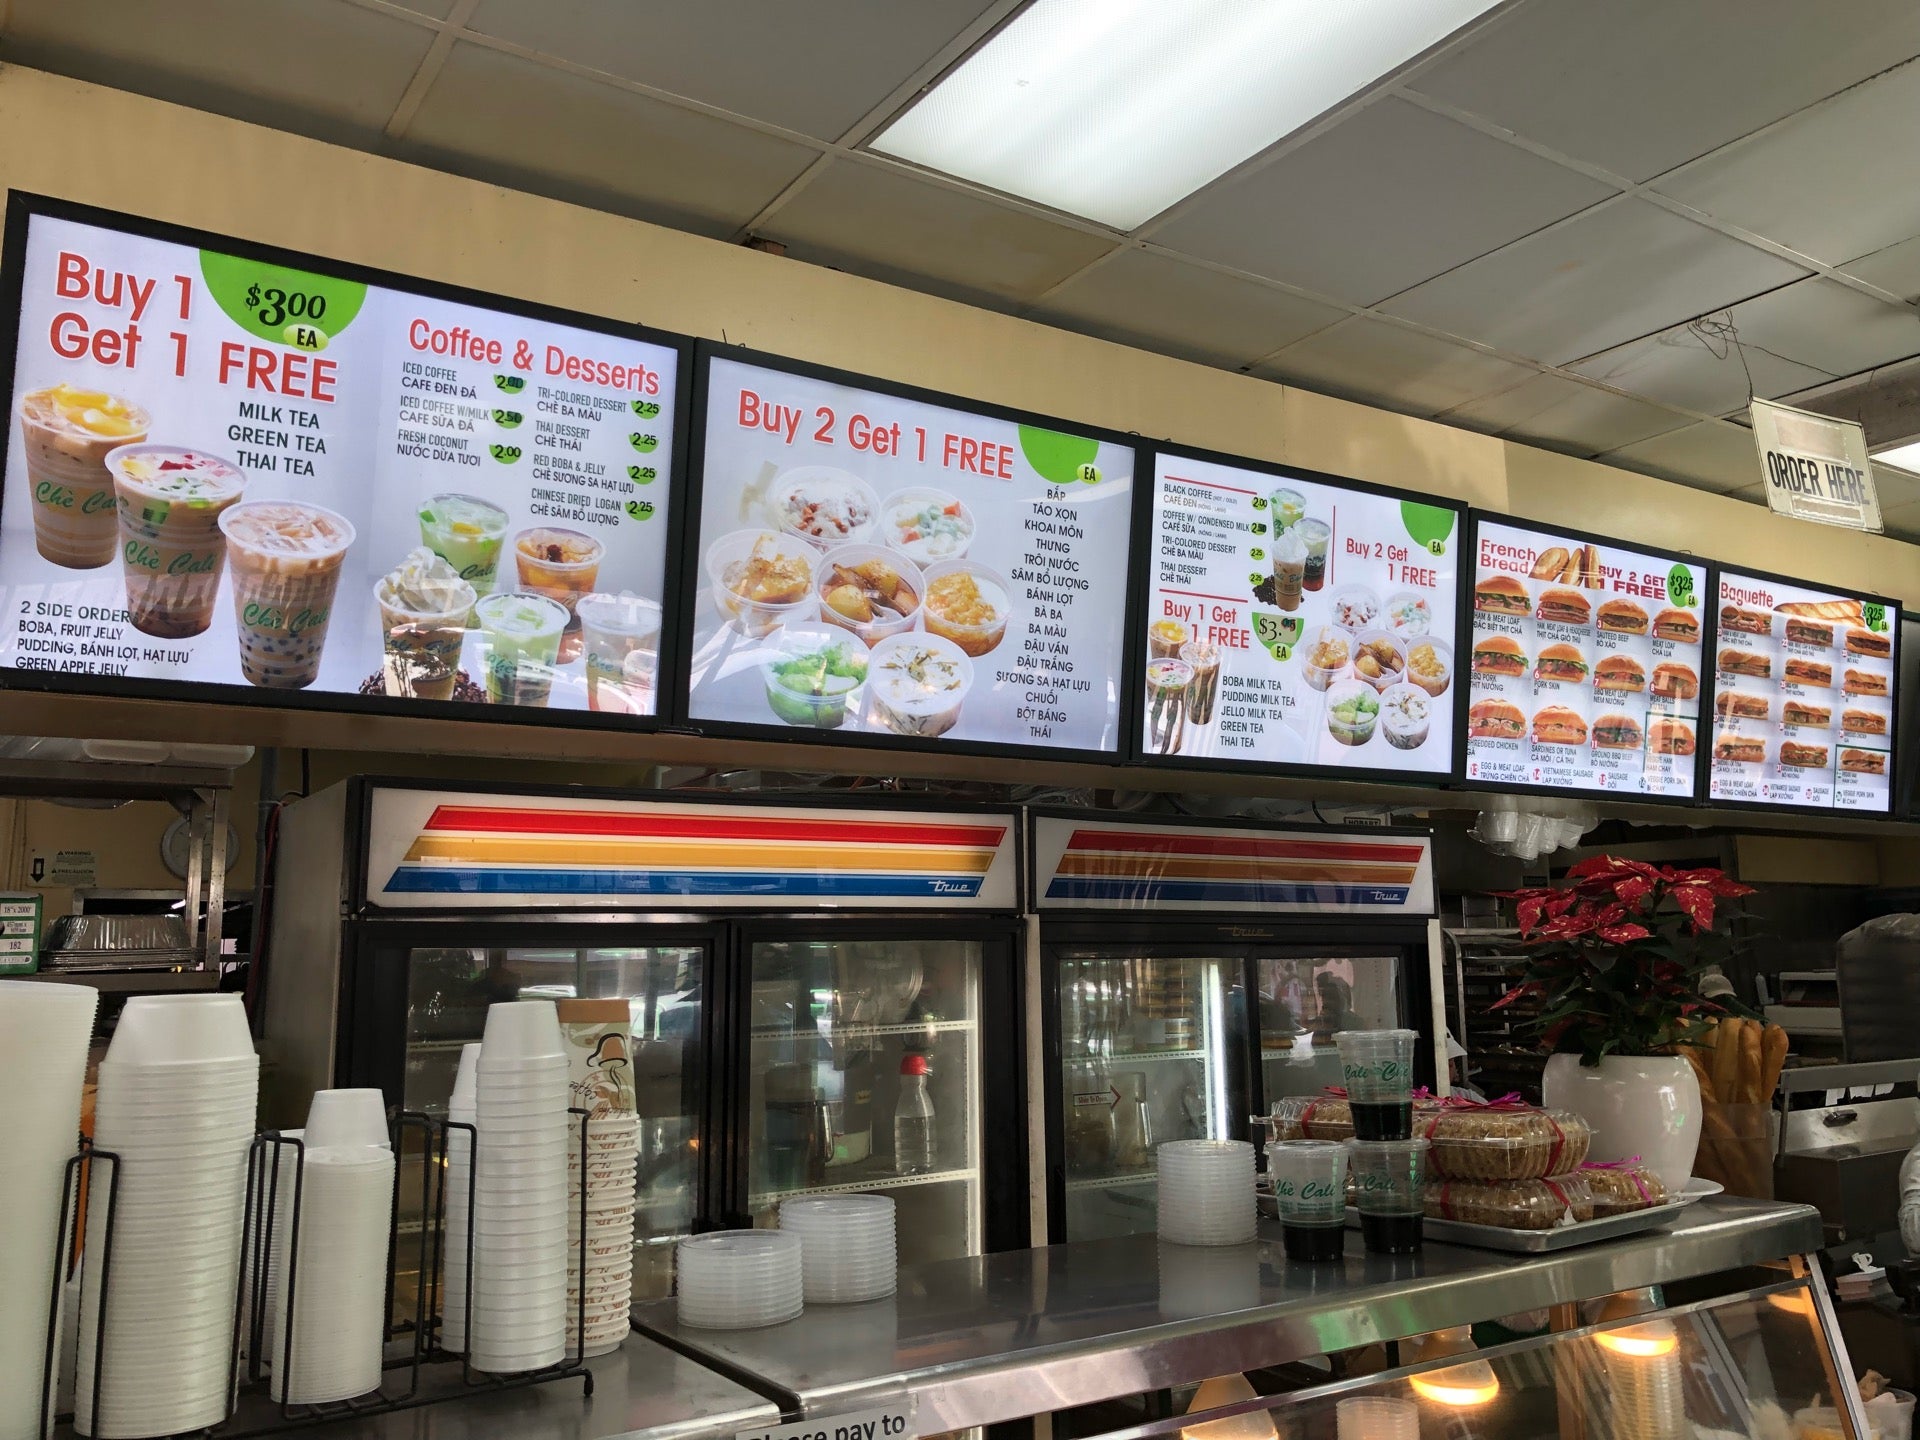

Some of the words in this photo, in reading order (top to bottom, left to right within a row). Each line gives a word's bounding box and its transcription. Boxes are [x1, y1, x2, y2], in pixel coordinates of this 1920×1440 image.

[57, 252, 156, 321] Buy
[174, 275, 191, 319] 1
[297, 328, 318, 347] EA
[51, 313, 141, 368] Get
[170, 332, 188, 377] 1
[219, 342, 338, 402] FREE
[410, 319, 502, 364] Coffee
[512, 340, 533, 370] &
[546, 346, 659, 394] Desserts
[403, 361, 422, 375] ICED
[425, 366, 456, 381] COFFEE
[402, 377, 431, 391] CAFE
[435, 382, 457, 395] ĐEN
[461, 387, 476, 399] ĐÁ
[400, 395, 419, 408] ICED
[423, 400, 454, 415] COFFEE
[457, 405, 489, 420] W/MILK
[538, 387, 590, 406] TRI-COLORED
[594, 398, 626, 412] DESSERT
[635, 401, 659, 414] 2.25
[239, 402, 282, 423] MILK
[289, 411, 319, 428] TEA
[400, 410, 428, 424] CAFE
[537, 401, 558, 413] CHÈ
[562, 406, 575, 417] BA
[578, 408, 601, 421] MÀU
[536, 420, 553, 433] THAI
[556, 424, 590, 439] DESSERT
[739, 390, 801, 444] Buy
[814, 407, 834, 442] 2
[848, 415, 900, 456] Get
[914, 428, 925, 461] 1
[944, 434, 1013, 480] FREE
[228, 425, 288, 449] GREEN
[296, 436, 326, 454] TEA
[399, 429, 426, 443] FRESH
[429, 435, 468, 450] COCONUT
[535, 435, 556, 446] CHÈ
[560, 438, 581, 451] THÁI
[632, 433, 656, 446] 2.25
[494, 445, 521, 458] 2.00
[237, 451, 276, 471] THAI
[285, 459, 314, 476] TEA
[534, 454, 549, 466] RED
[552, 457, 572, 470] BOBA
[584, 461, 605, 475] JELLY
[631, 466, 655, 479] 2.25
[533, 468, 550, 480] CHÈ
[588, 478, 599, 488] SA
[1084, 467, 1096, 481] EA
[1767, 451, 1823, 497] ORDER
[1825, 464, 1870, 505] HERE
[532, 488, 565, 502] CHINESE
[568, 493, 590, 507] DRIED
[596, 497, 621, 511] LOGAN
[1164, 484, 1185, 496] BLACK
[1188, 488, 1212, 499] COFFEE
[531, 503, 548, 515] CHÈ
[629, 501, 652, 514] 2.25
[1033, 502, 1052, 516] TÁO
[1056, 508, 1077, 521] XỌN
[1253, 497, 1267, 508] 2.00
[1025, 520, 1056, 534] KHOAI
[1059, 527, 1083, 538] MÔN
[1163, 510, 1185, 521] COFFEE
[1198, 516, 1234, 529] CONDENSED
[1236, 523, 1249, 532] MILK
[1162, 535, 1206, 549] TRI-COLORED
[1208, 542, 1236, 554] DESSERT
[1347, 538, 1369, 558] Buy
[1375, 543, 1382, 557] 2
[1388, 545, 1408, 562] Get
[1433, 542, 1441, 553] EA
[1482, 539, 1536, 561] French
[1024, 553, 1046, 566] TRÔI
[1481, 554, 1528, 574] Bread
[1012, 569, 1033, 581] SÂM
[1161, 562, 1176, 572] THAI
[1178, 564, 1207, 576] DESSERT
[1388, 564, 1393, 580] 1
[1402, 566, 1436, 587] FREE
[1599, 565, 1622, 579] BUY
[1629, 572, 1636, 582] 2
[1644, 574, 1665, 587] GET
[1027, 588, 1054, 601] BÁNH
[1614, 580, 1665, 600] FREE
[1721, 583, 1773, 607] Baguette
[21, 601, 30, 613] 2
[37, 603, 72, 617] SIDE
[1050, 610, 1062, 620] BA
[1164, 600, 1191, 622] Buy
[1199, 604, 1204, 619] 1
[1212, 606, 1236, 624] Get
[19, 620, 56, 636] BOBA,
[61, 624, 91, 637] FRUIT
[94, 627, 123, 640] JELLY
[1029, 624, 1041, 634] BA
[1044, 624, 1066, 637] MÀU
[1209, 626, 1249, 648] FREE
[18, 638, 76, 656] PUDDING,
[81, 641, 114, 657] BÁNH
[1048, 642, 1068, 655] VÁN
[1277, 646, 1286, 658] EA
[16, 657, 56, 671] GREEN
[61, 661, 95, 674] APPLE
[98, 664, 128, 676] JELLY
[1037, 676, 1050, 687] SA
[1223, 676, 1243, 687] BOBA
[1247, 678, 1265, 689] MILK
[1268, 680, 1281, 690] TEA
[1222, 691, 1257, 703] PUDDING
[1260, 695, 1279, 705] MILK
[1282, 697, 1295, 706] TEA
[1038, 710, 1066, 722] BÁNG
[1221, 706, 1245, 717] JELLO
[1248, 708, 1266, 718] MILK
[1269, 710, 1282, 720] TEA
[1030, 726, 1051, 738] THÁI
[1221, 721, 1247, 732] GREEN
[1250, 723, 1263, 733] TEA
[1221, 736, 1238, 746] THAI
[1241, 738, 1254, 747] TEA
[1496, 741, 1518, 750] CHICKEN
[1531, 745, 1554, 754] SARDINES
[1591, 751, 1610, 759] GROUND
[1543, 767, 1571, 776] VIETNAMESE
[928, 880, 970, 892] true
[1370, 891, 1400, 900] true
[882, 1415, 905, 1435] to
